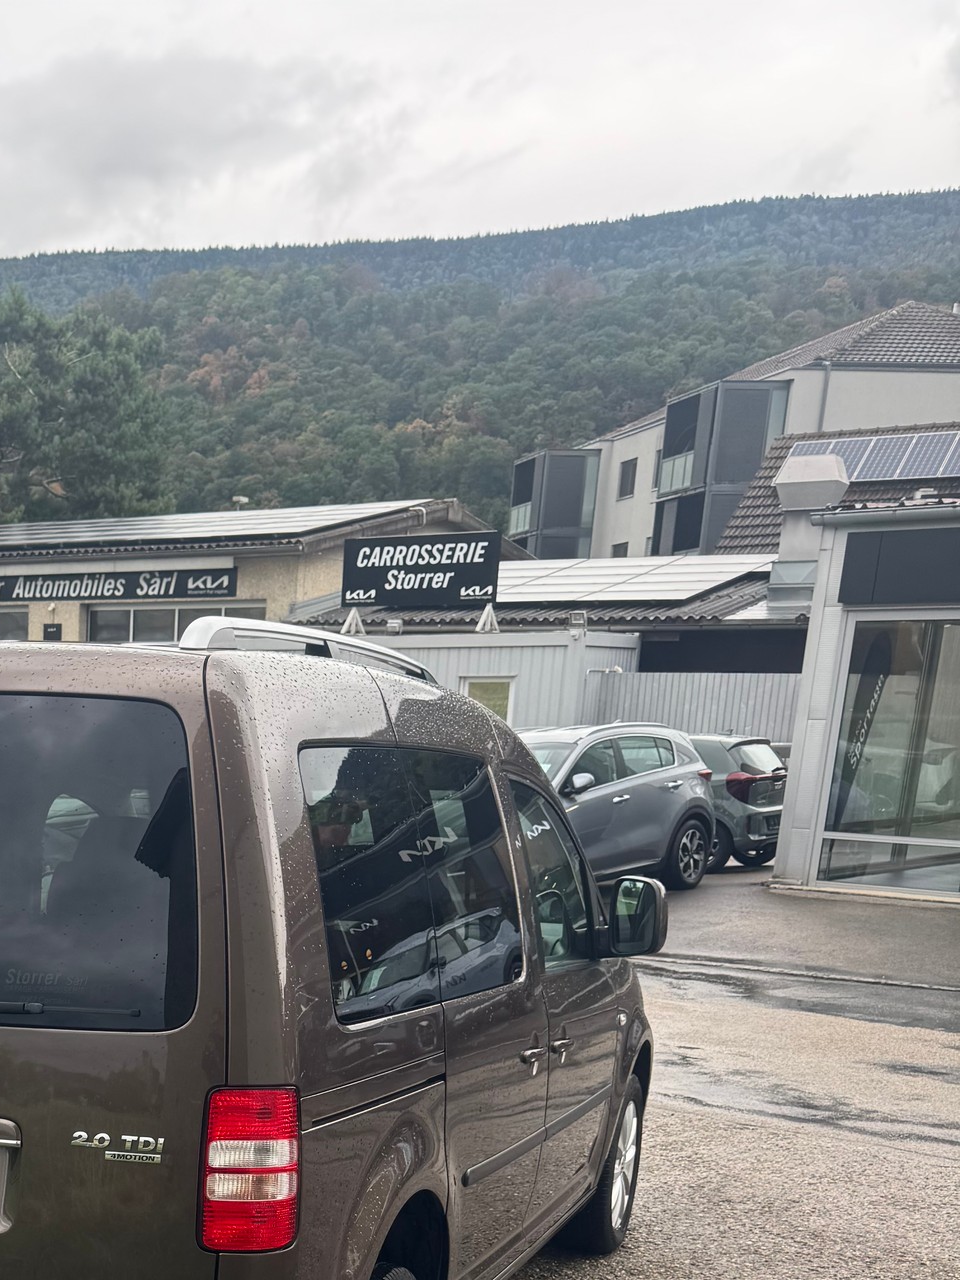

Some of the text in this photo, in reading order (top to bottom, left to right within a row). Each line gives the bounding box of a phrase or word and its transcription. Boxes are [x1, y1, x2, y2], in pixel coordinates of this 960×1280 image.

[356, 541, 488, 568] CARROSSERIE
[12, 573, 125, 599] Automobiles
[136, 571, 178, 596] Sàrl
[384, 569, 454, 590] Storrer
[5, 968, 62, 985] Storrer
[71, 1131, 165, 1152] 2.0 TDI
[110, 1153, 155, 1162] 4MOTION
